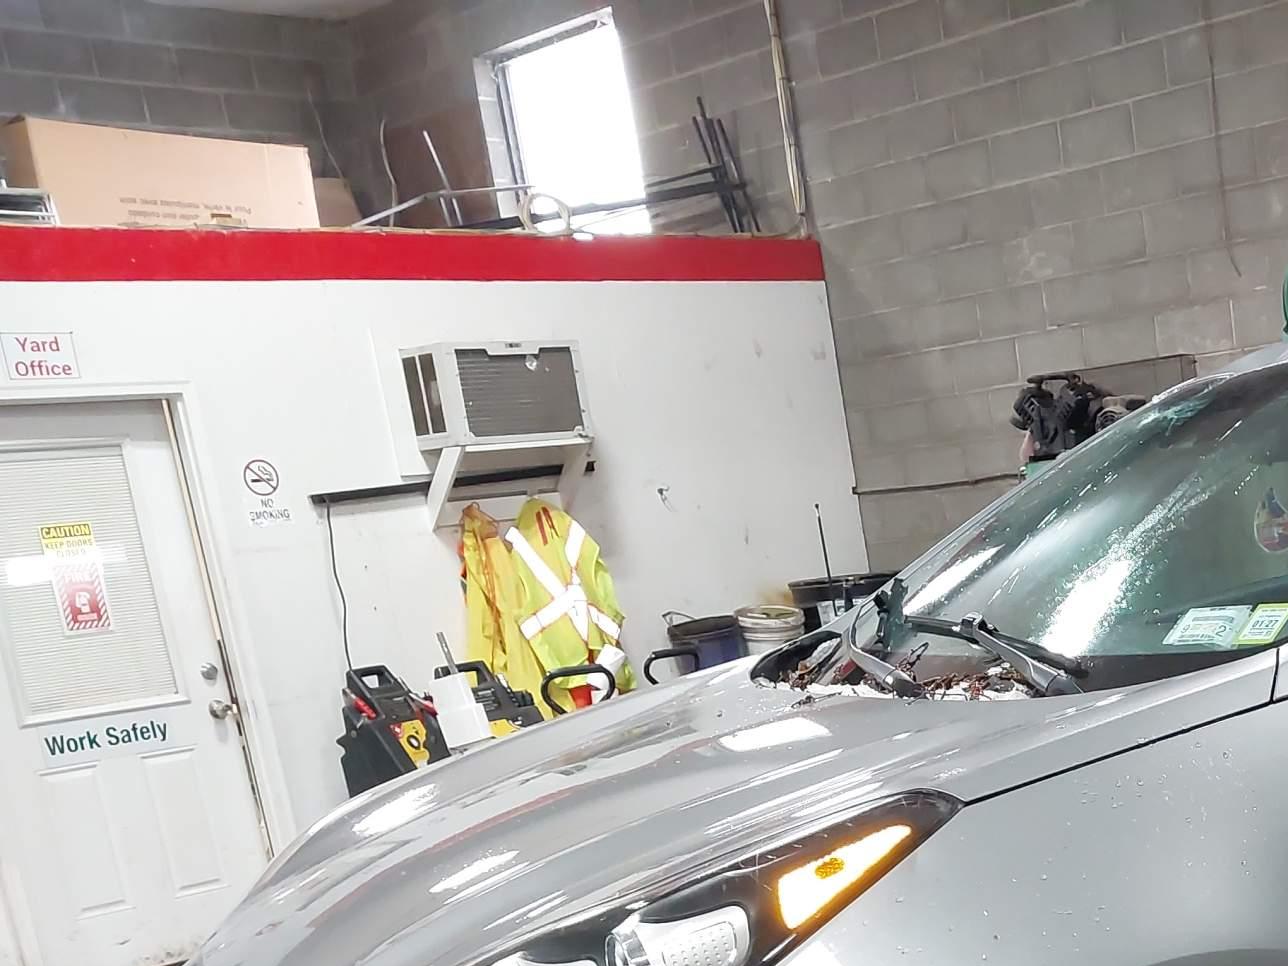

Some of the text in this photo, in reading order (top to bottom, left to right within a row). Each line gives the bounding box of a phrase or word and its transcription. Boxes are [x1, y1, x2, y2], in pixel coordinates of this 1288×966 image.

[14, 335, 60, 353] Yard
[14, 359, 73, 377] Office
[260, 497, 274, 509] NO
[249, 508, 290, 521] SMOKING
[42, 524, 91, 539] CAUTION
[44, 538, 93, 550] KEEP DOORS
[44, 720, 169, 756] Work Safely
